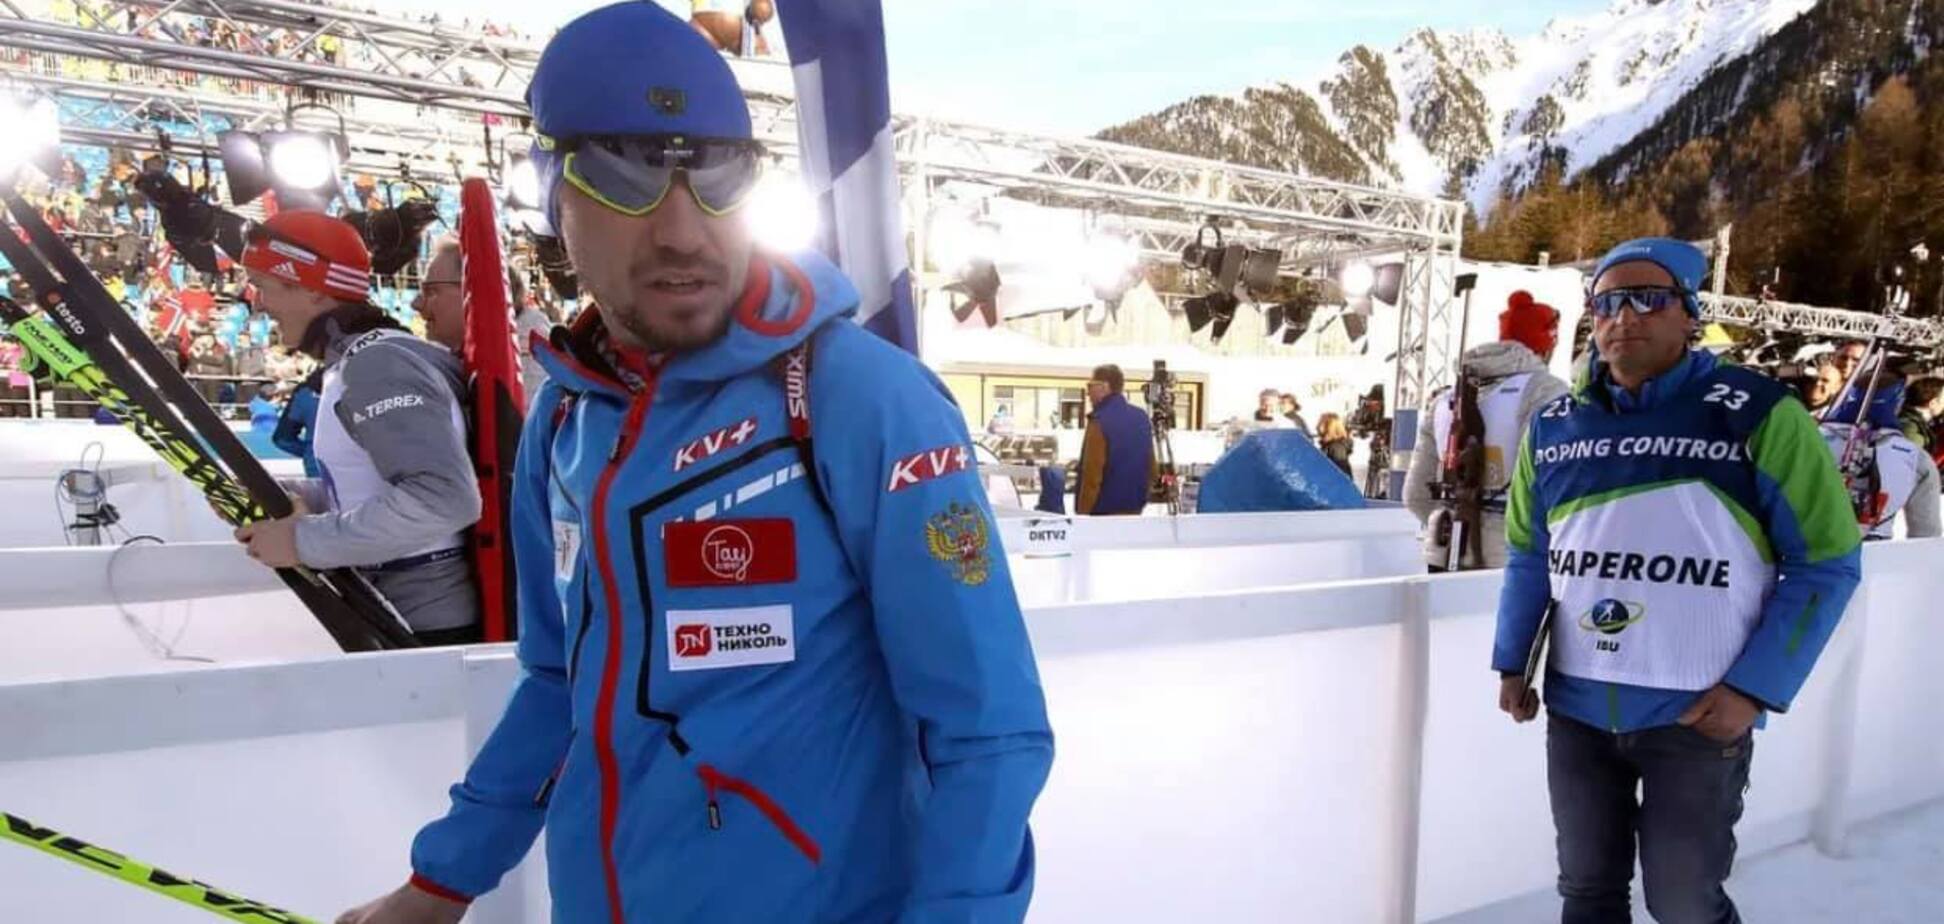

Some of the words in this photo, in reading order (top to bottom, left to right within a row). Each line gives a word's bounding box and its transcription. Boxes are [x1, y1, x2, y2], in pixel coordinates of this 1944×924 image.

[55, 302, 85, 334] testo
[365, 394, 424, 418] TERREX
[1704, 383, 1749, 410] 23
[674, 418, 756, 472] KV+
[1618, 436, 1742, 462] CONTROL
[889, 446, 969, 492] KV+
[1550, 550, 1730, 588] HAPERONE
[714, 623, 771, 637] ТЕХНО
[717, 635, 787, 651] НИКОЛЬ
[1596, 640, 1620, 652] IBU
